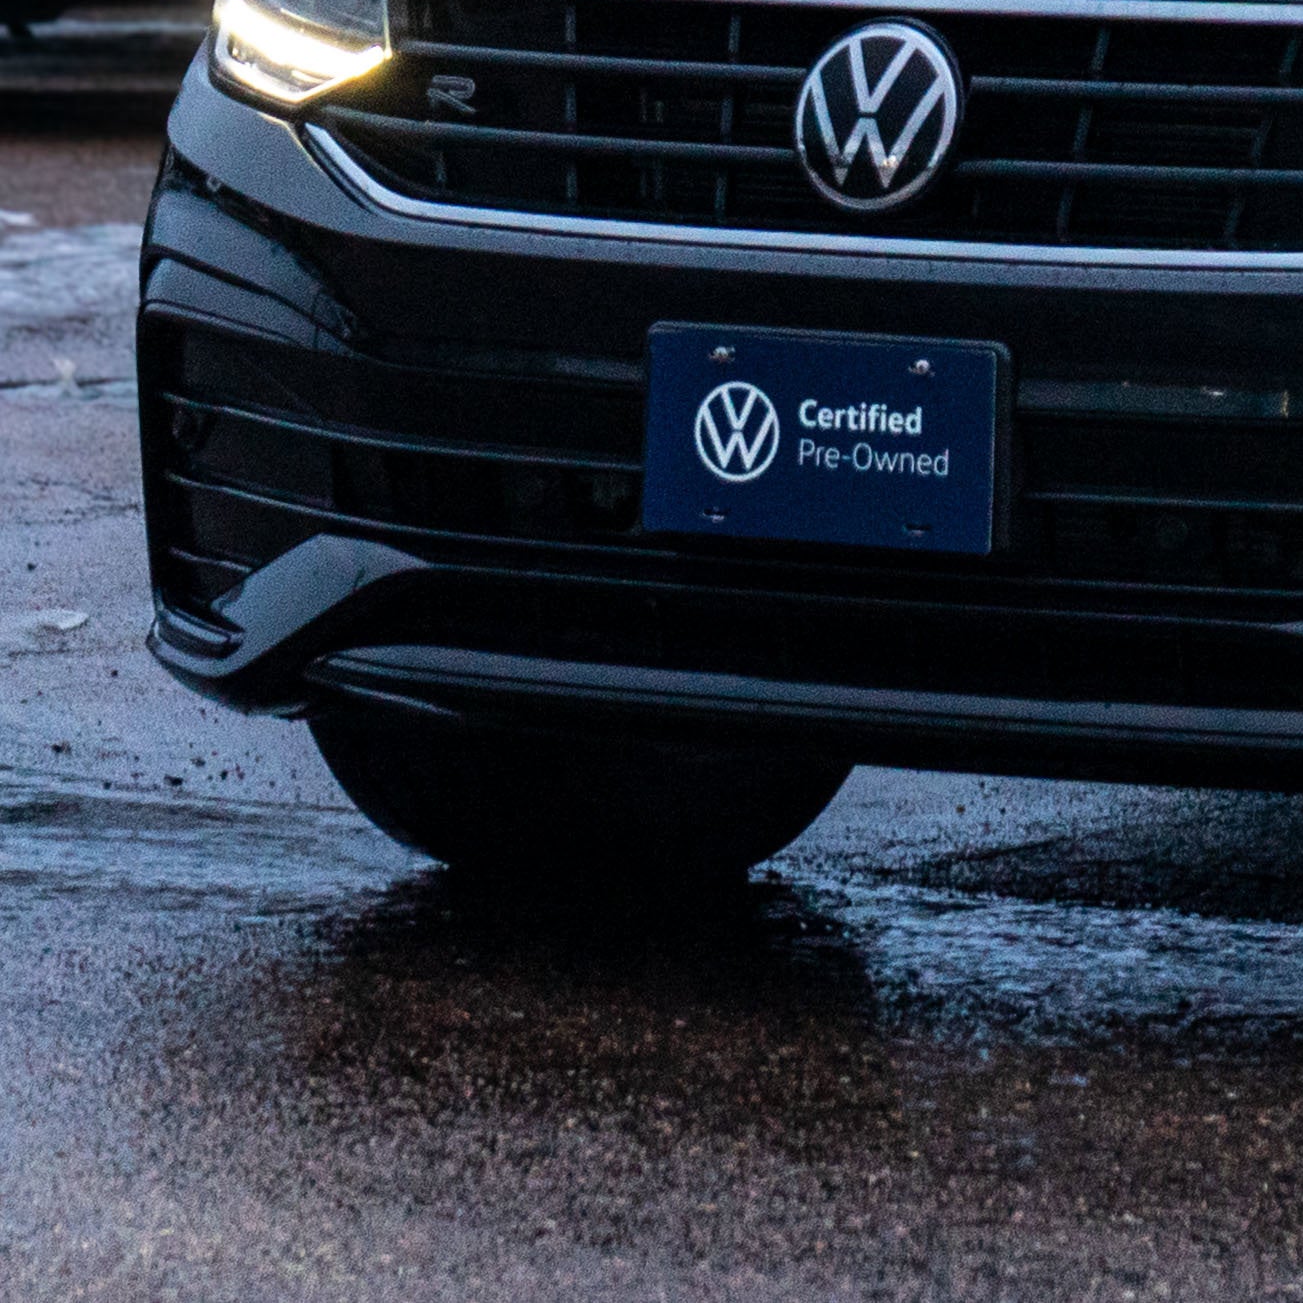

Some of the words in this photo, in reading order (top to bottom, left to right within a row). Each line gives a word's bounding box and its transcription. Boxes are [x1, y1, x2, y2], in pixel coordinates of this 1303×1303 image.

[427, 74, 477, 113] R
[796, 22, 957, 212] VW
[694, 381, 780, 483] VW
[798, 398, 923, 436] Certified
[798, 438, 950, 476] Pre-Owned
